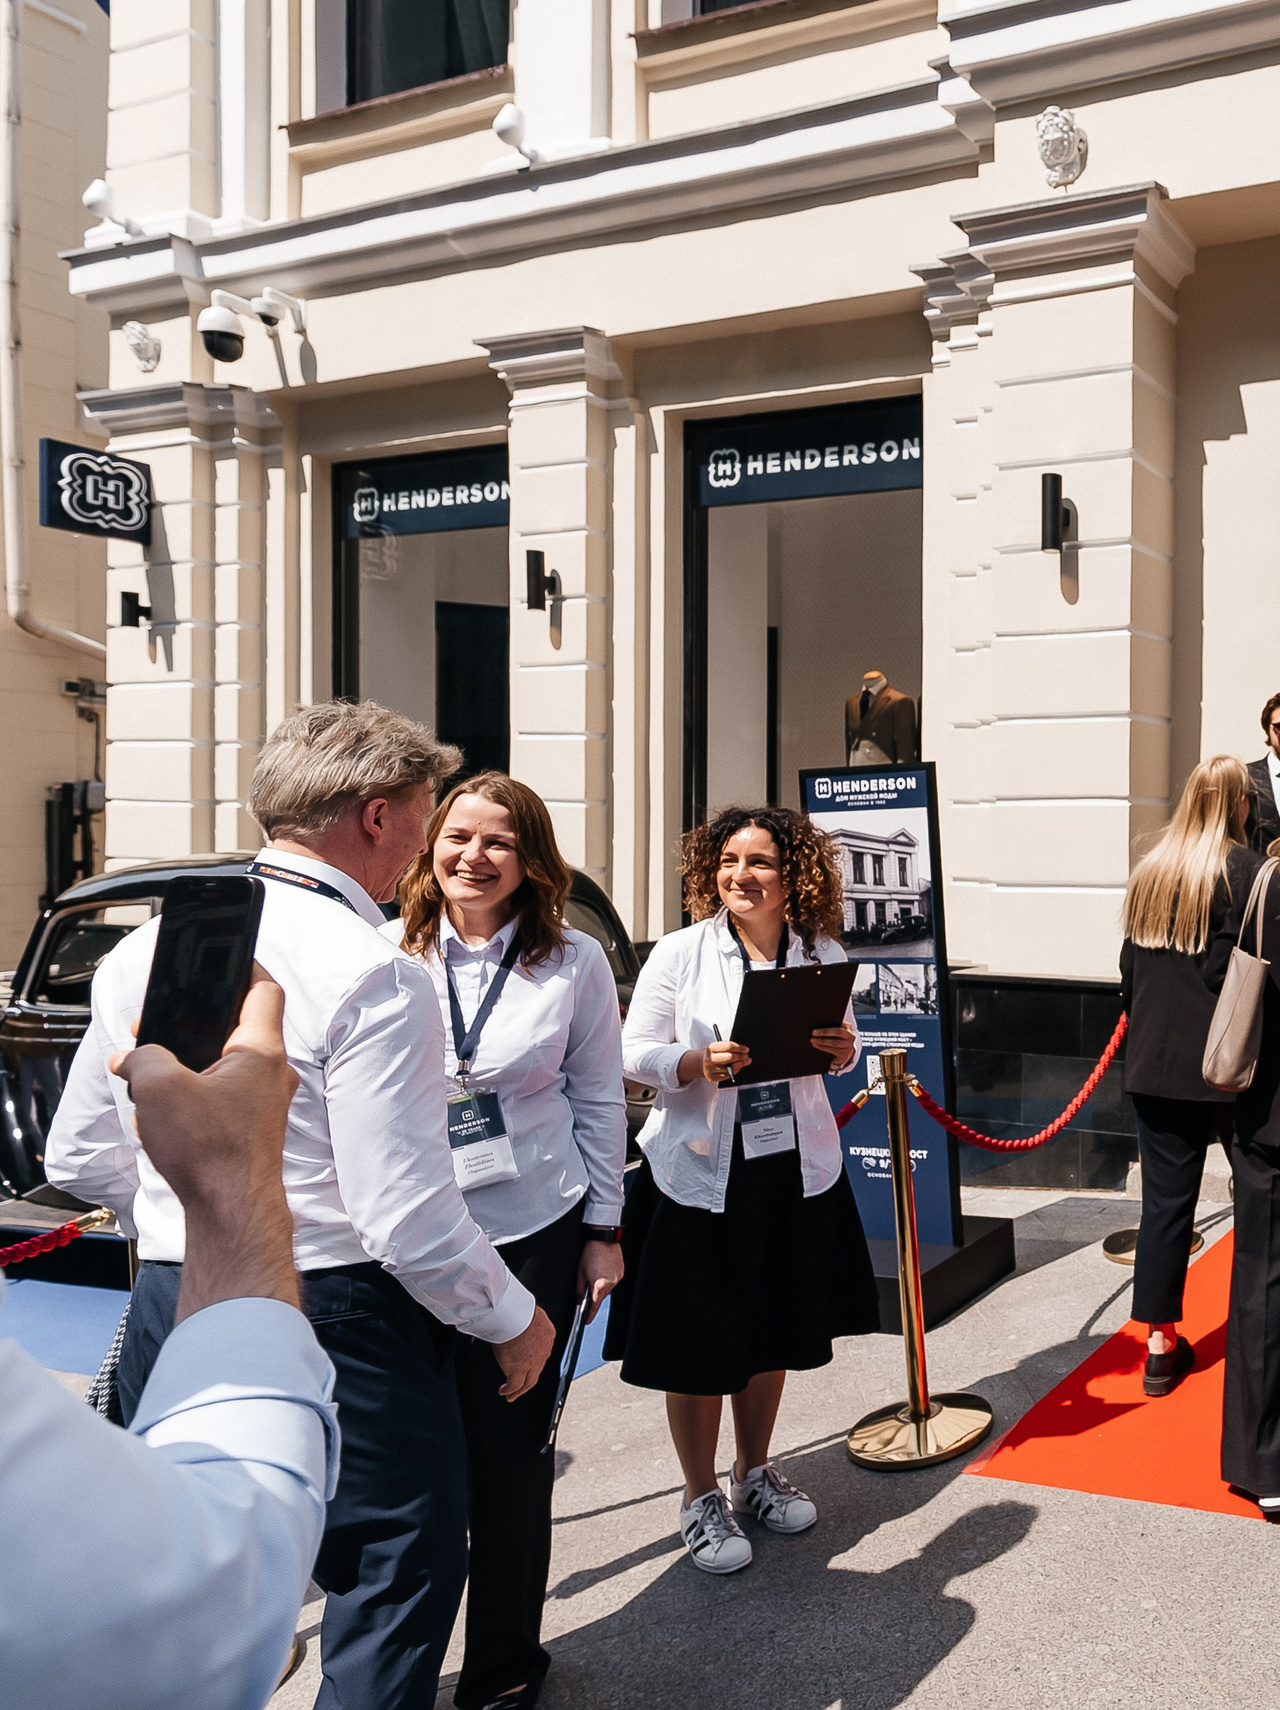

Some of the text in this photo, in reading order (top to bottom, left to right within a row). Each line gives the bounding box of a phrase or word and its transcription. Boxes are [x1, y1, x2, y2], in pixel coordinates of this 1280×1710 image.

[747, 437, 920, 476] HENDERSON
[86, 474, 125, 510] H
[382, 480, 511, 512] HENDERSON
[833, 777, 916, 793] HENDERSON
[449, 1117, 490, 1132] HENDERSON
[908, 1149, 928, 1160] ОСТ
